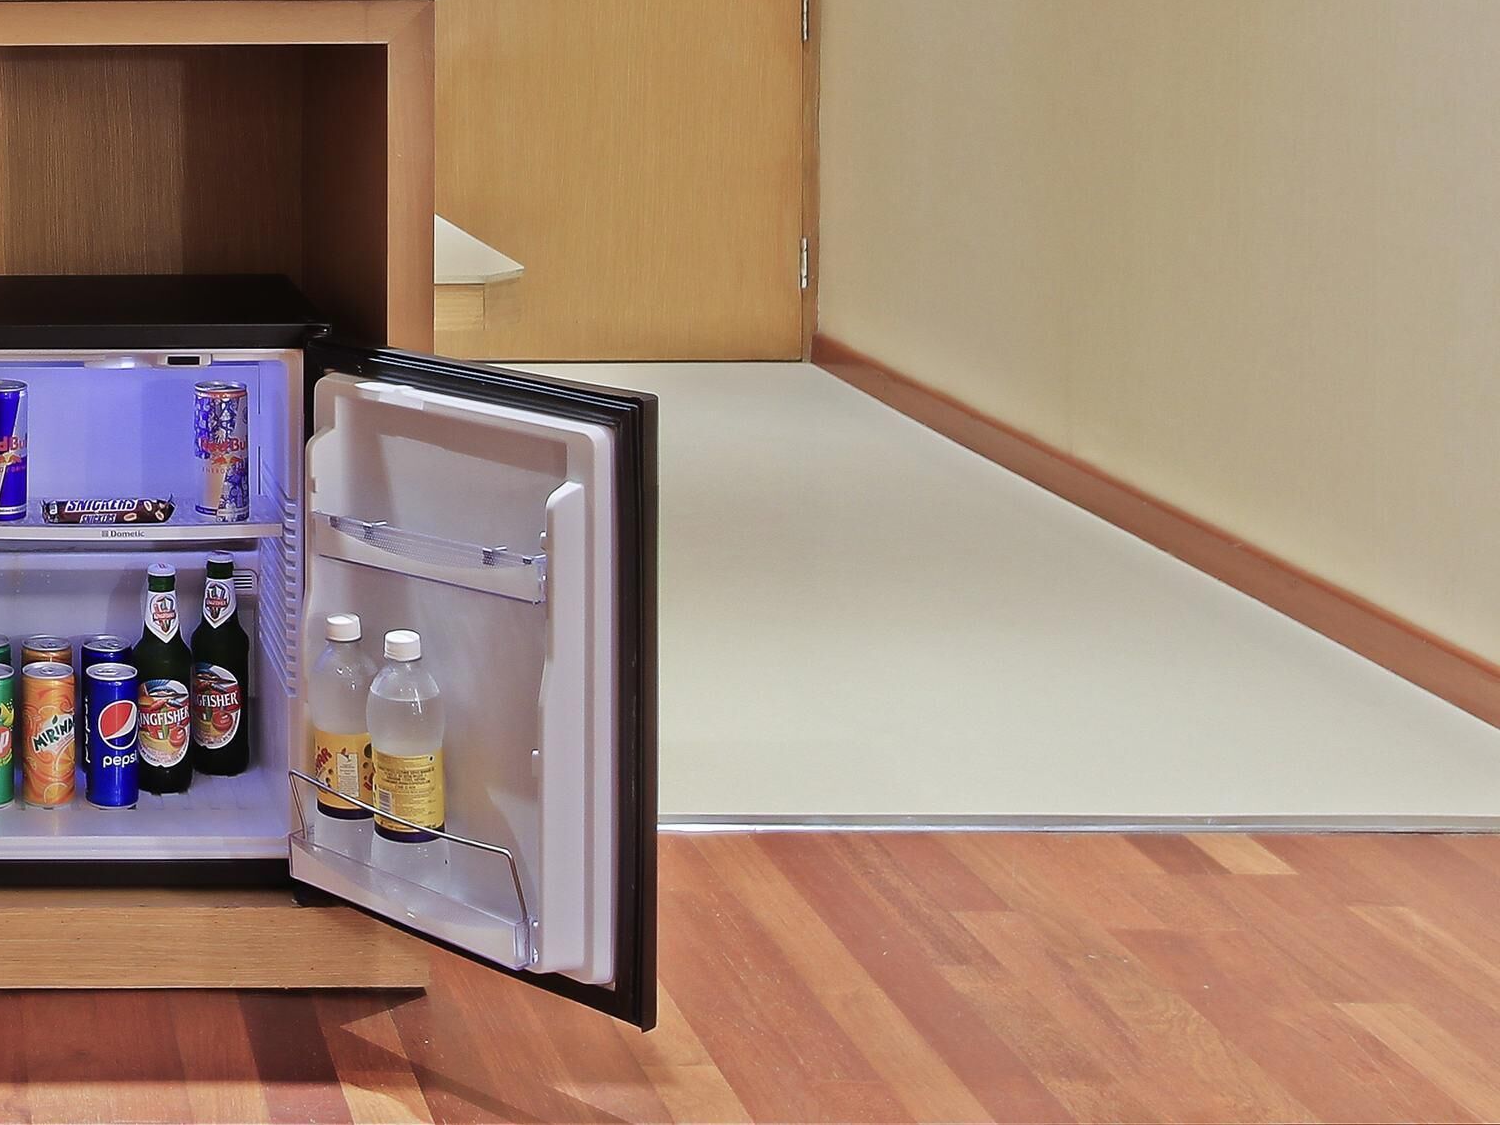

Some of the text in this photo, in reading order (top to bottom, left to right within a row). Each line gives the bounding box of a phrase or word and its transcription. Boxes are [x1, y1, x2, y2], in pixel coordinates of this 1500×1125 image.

[64, 499, 139, 514] SNICKERS
[109, 529, 146, 539] Dometic
[139, 706, 190, 727] INGFISHER
[102, 749, 139, 769] pepsi
